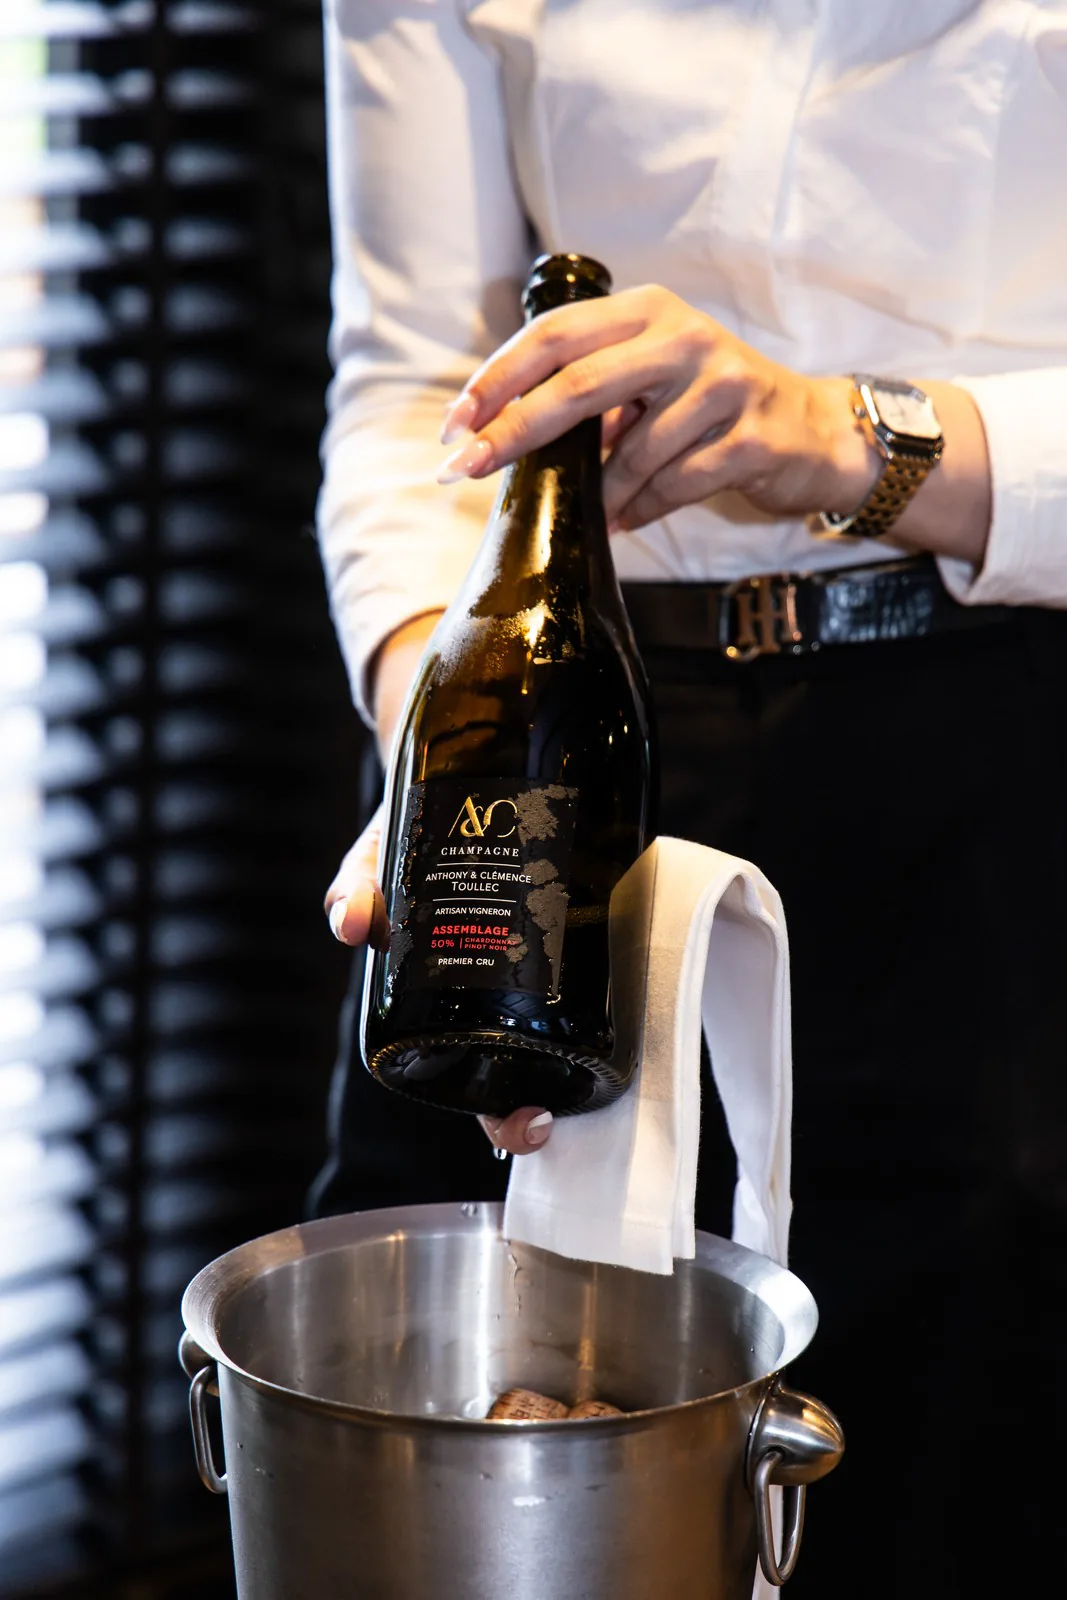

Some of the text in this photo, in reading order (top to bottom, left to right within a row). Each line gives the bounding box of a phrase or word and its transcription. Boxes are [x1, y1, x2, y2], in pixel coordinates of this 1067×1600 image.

[441, 846, 520, 857] CHAMPAGNE
[425, 870, 532, 884] ANTHONY & CLÉMENCE
[451, 881, 500, 892] TOULLEC
[435, 907, 511, 917] ARTISAN VIGNERON
[432, 925, 509, 936] ASSEMBLAGE
[431, 939, 454, 948] 50%
[438, 957, 495, 966] PREMIER CRU
